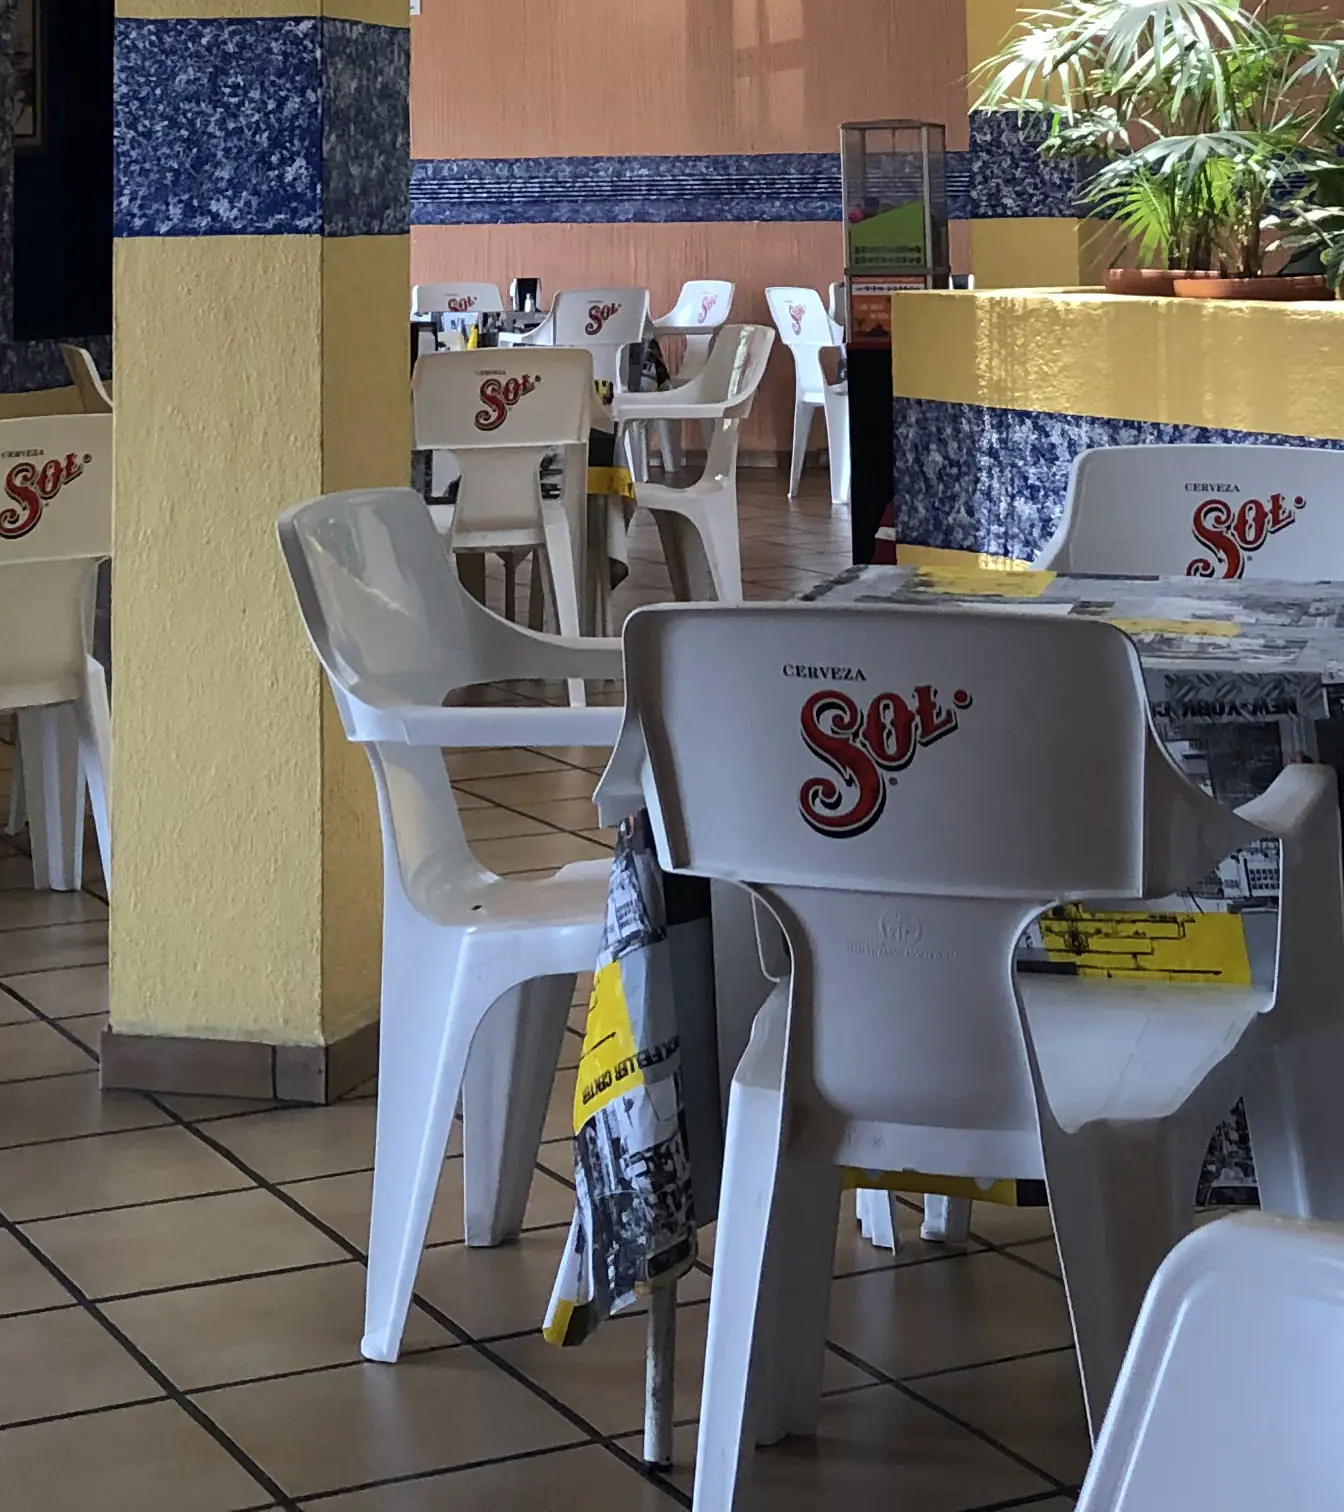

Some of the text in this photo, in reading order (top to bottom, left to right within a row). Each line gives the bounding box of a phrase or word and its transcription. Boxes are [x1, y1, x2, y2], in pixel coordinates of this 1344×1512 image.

[474, 374, 535, 431] SOL
[1184, 482, 1240, 493] CERVEZA
[1186, 493, 1296, 580] SOL
[782, 663, 867, 682] CERVEZA
[798, 684, 960, 839] SOL
